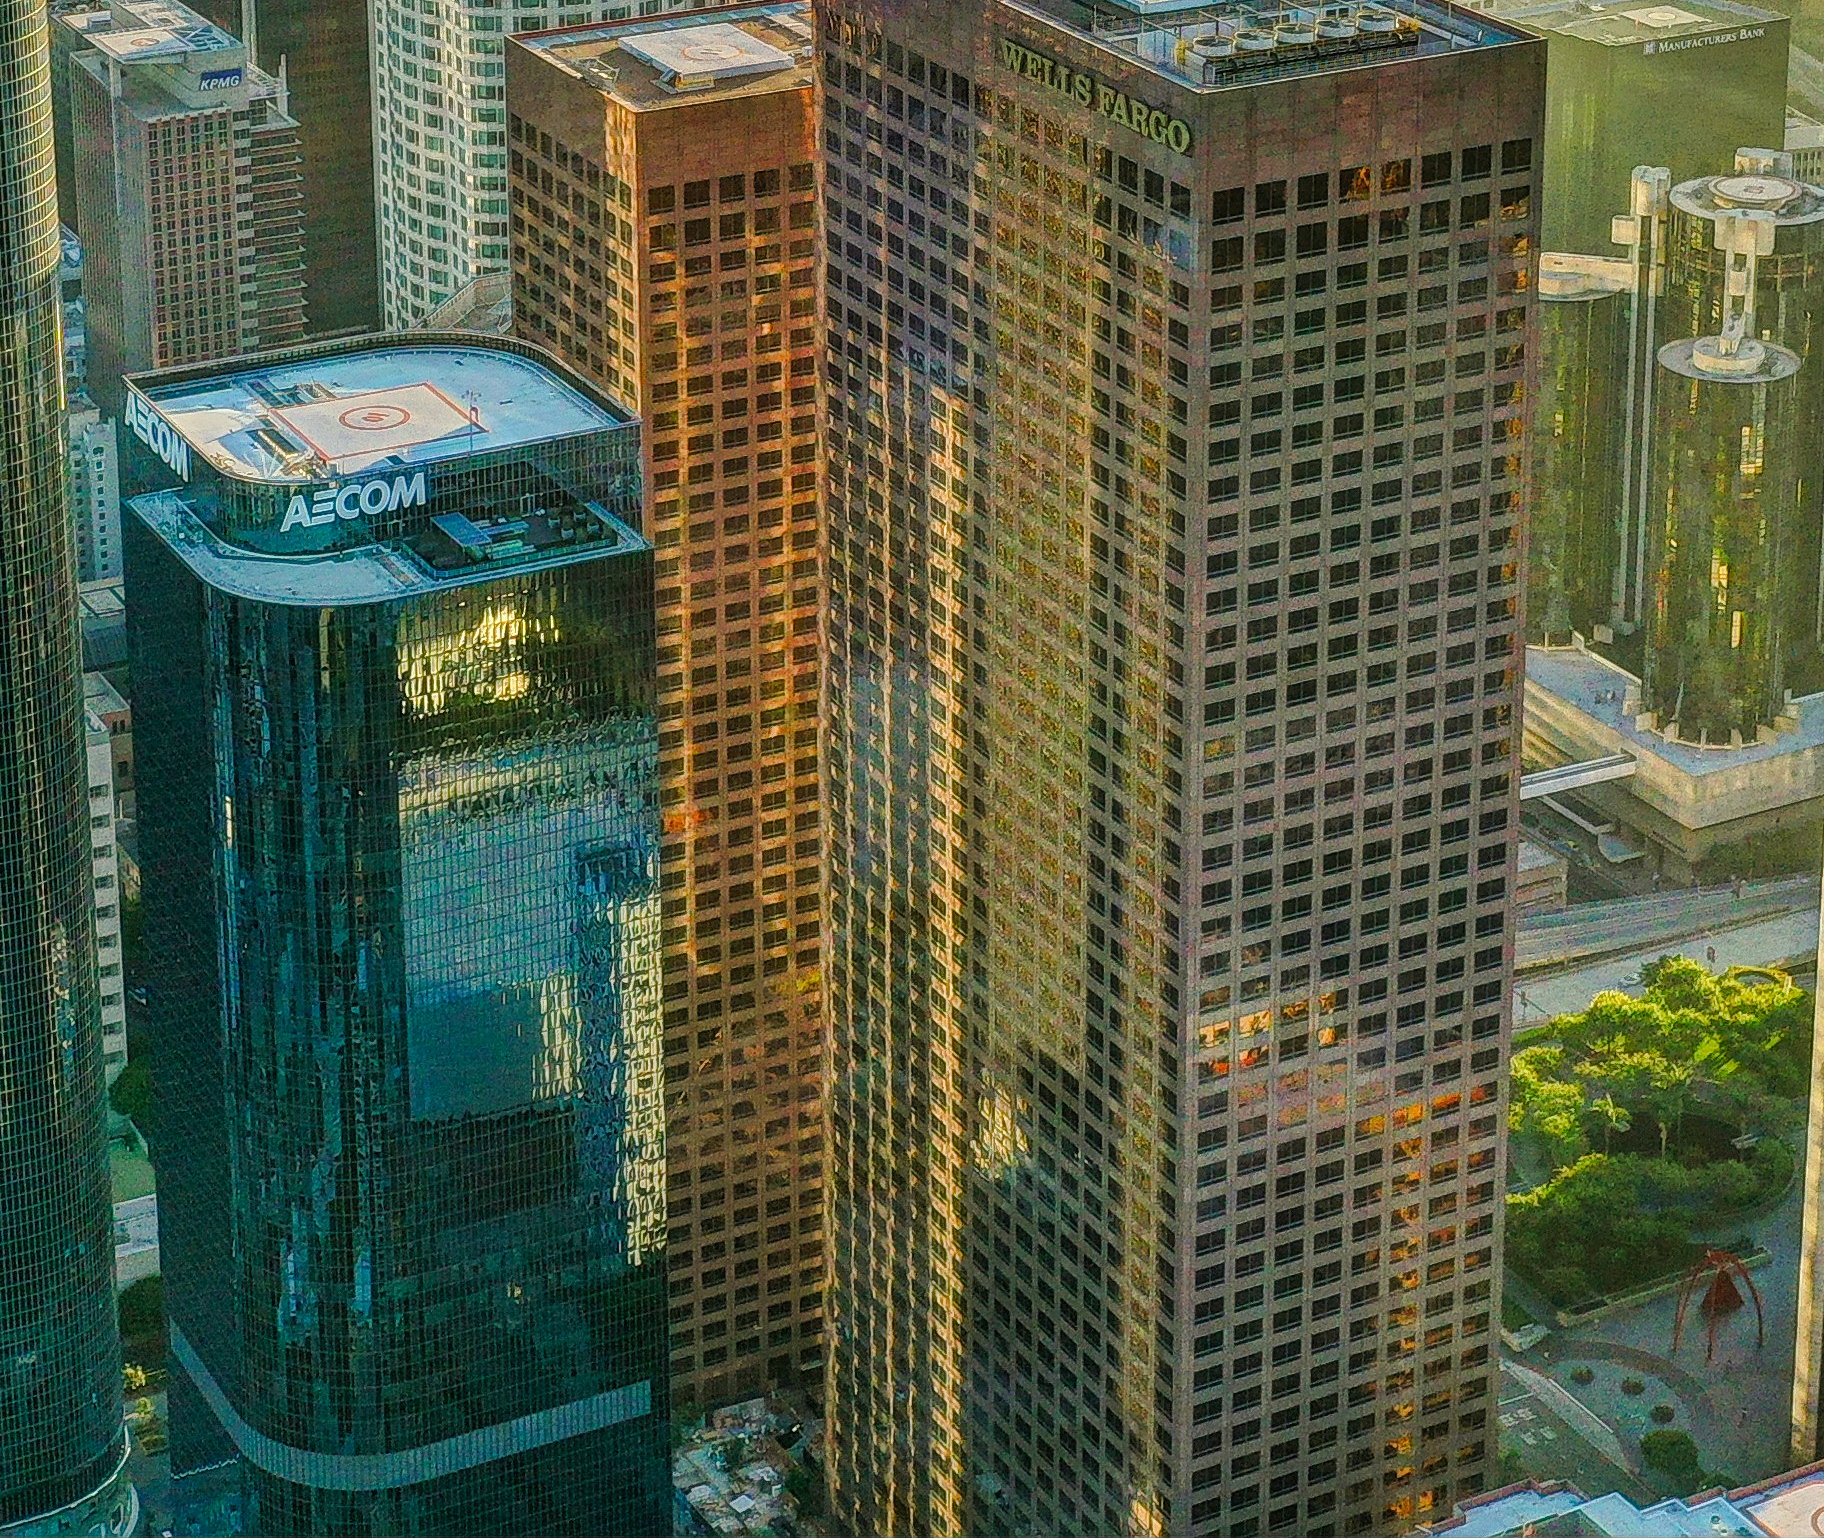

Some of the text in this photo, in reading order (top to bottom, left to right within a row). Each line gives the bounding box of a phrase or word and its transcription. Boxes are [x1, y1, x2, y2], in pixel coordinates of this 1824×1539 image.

[200, 73, 241, 91] KPMG
[1002, 37, 1192, 154] WELLS FARGO
[124, 390, 191, 482] AECOM
[279, 472, 428, 533] AECOM
